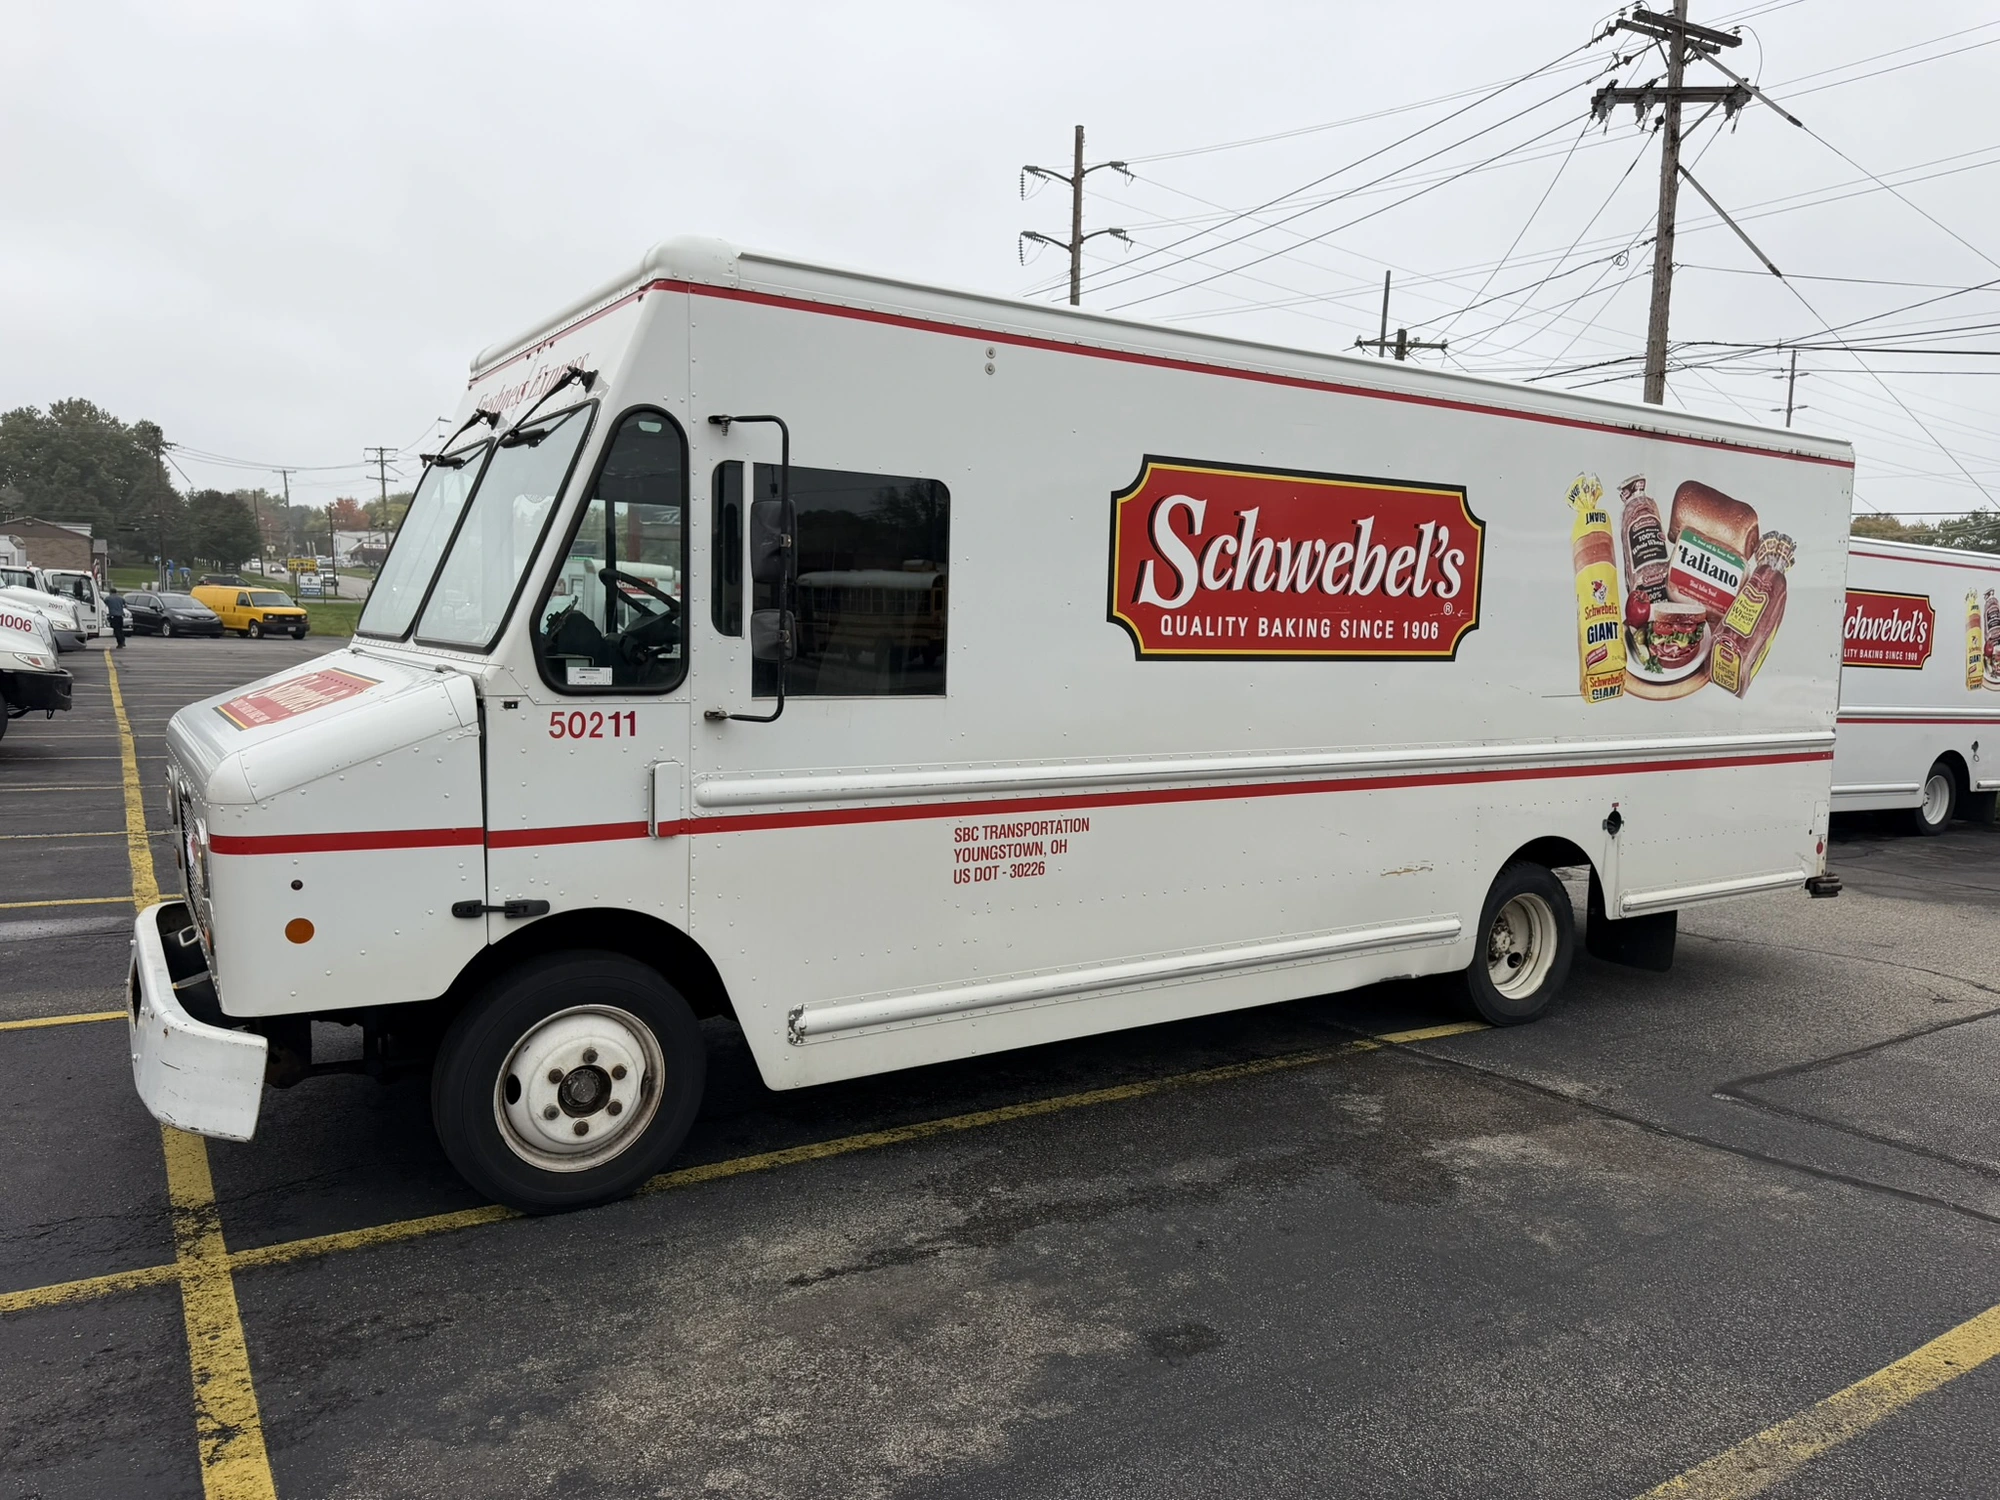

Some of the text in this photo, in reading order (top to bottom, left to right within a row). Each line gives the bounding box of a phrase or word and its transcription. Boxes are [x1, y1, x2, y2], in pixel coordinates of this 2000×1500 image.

[1585, 512, 1607, 525] GIANT
[1132, 494, 1465, 609] Schwebel's
[1160, 614, 1440, 640] QUALITY BAKING SINCE 1906
[1587, 622, 1618, 645] GIANT
[1844, 603, 1928, 643] chwebel's
[1843, 648, 1858, 658] LITY
[1860, 649, 1883, 659] BAKING
[1885, 650, 1903, 660] SINCE
[1592, 684, 1622, 701] GIANT
[549, 711, 636, 739] 50211
[954, 817, 1090, 843] SBC TRANSPORTATION
[953, 839, 1068, 864] YOUNGSTOWN, OH
[953, 868, 971, 885] US
[974, 865, 1000, 882] DOT
[1009, 861, 1045, 879] 30226
